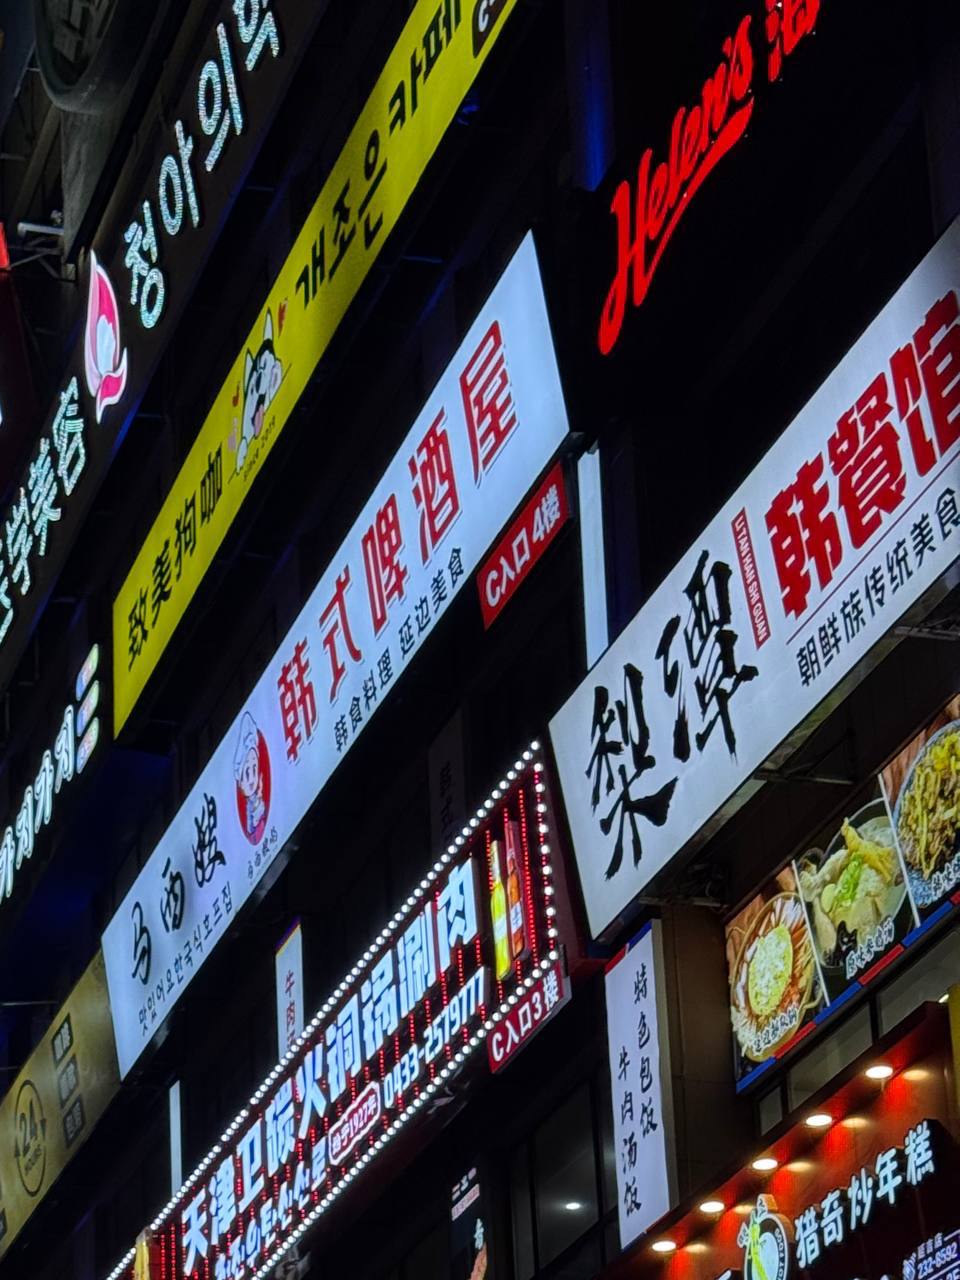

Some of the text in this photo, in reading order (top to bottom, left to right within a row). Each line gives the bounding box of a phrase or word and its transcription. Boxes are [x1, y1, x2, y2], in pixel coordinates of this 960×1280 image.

[598, 14, 753, 355] Helen's
[128, 440, 223, 673] 致美狗咖
[277, 320, 520, 765] 韩式啤酒屋
[795, 488, 960, 687] 朝鲜族传统美食
[334, 547, 465, 753] 韩食料理 延边美食
[383, 970, 486, 1108] 0433-2579777
[617, 1047, 642, 1218] 牛肉汤饭
[634, 963, 658, 1138] 特色包饭
[794, 1120, 935, 1268] 猎奇炒年糕
